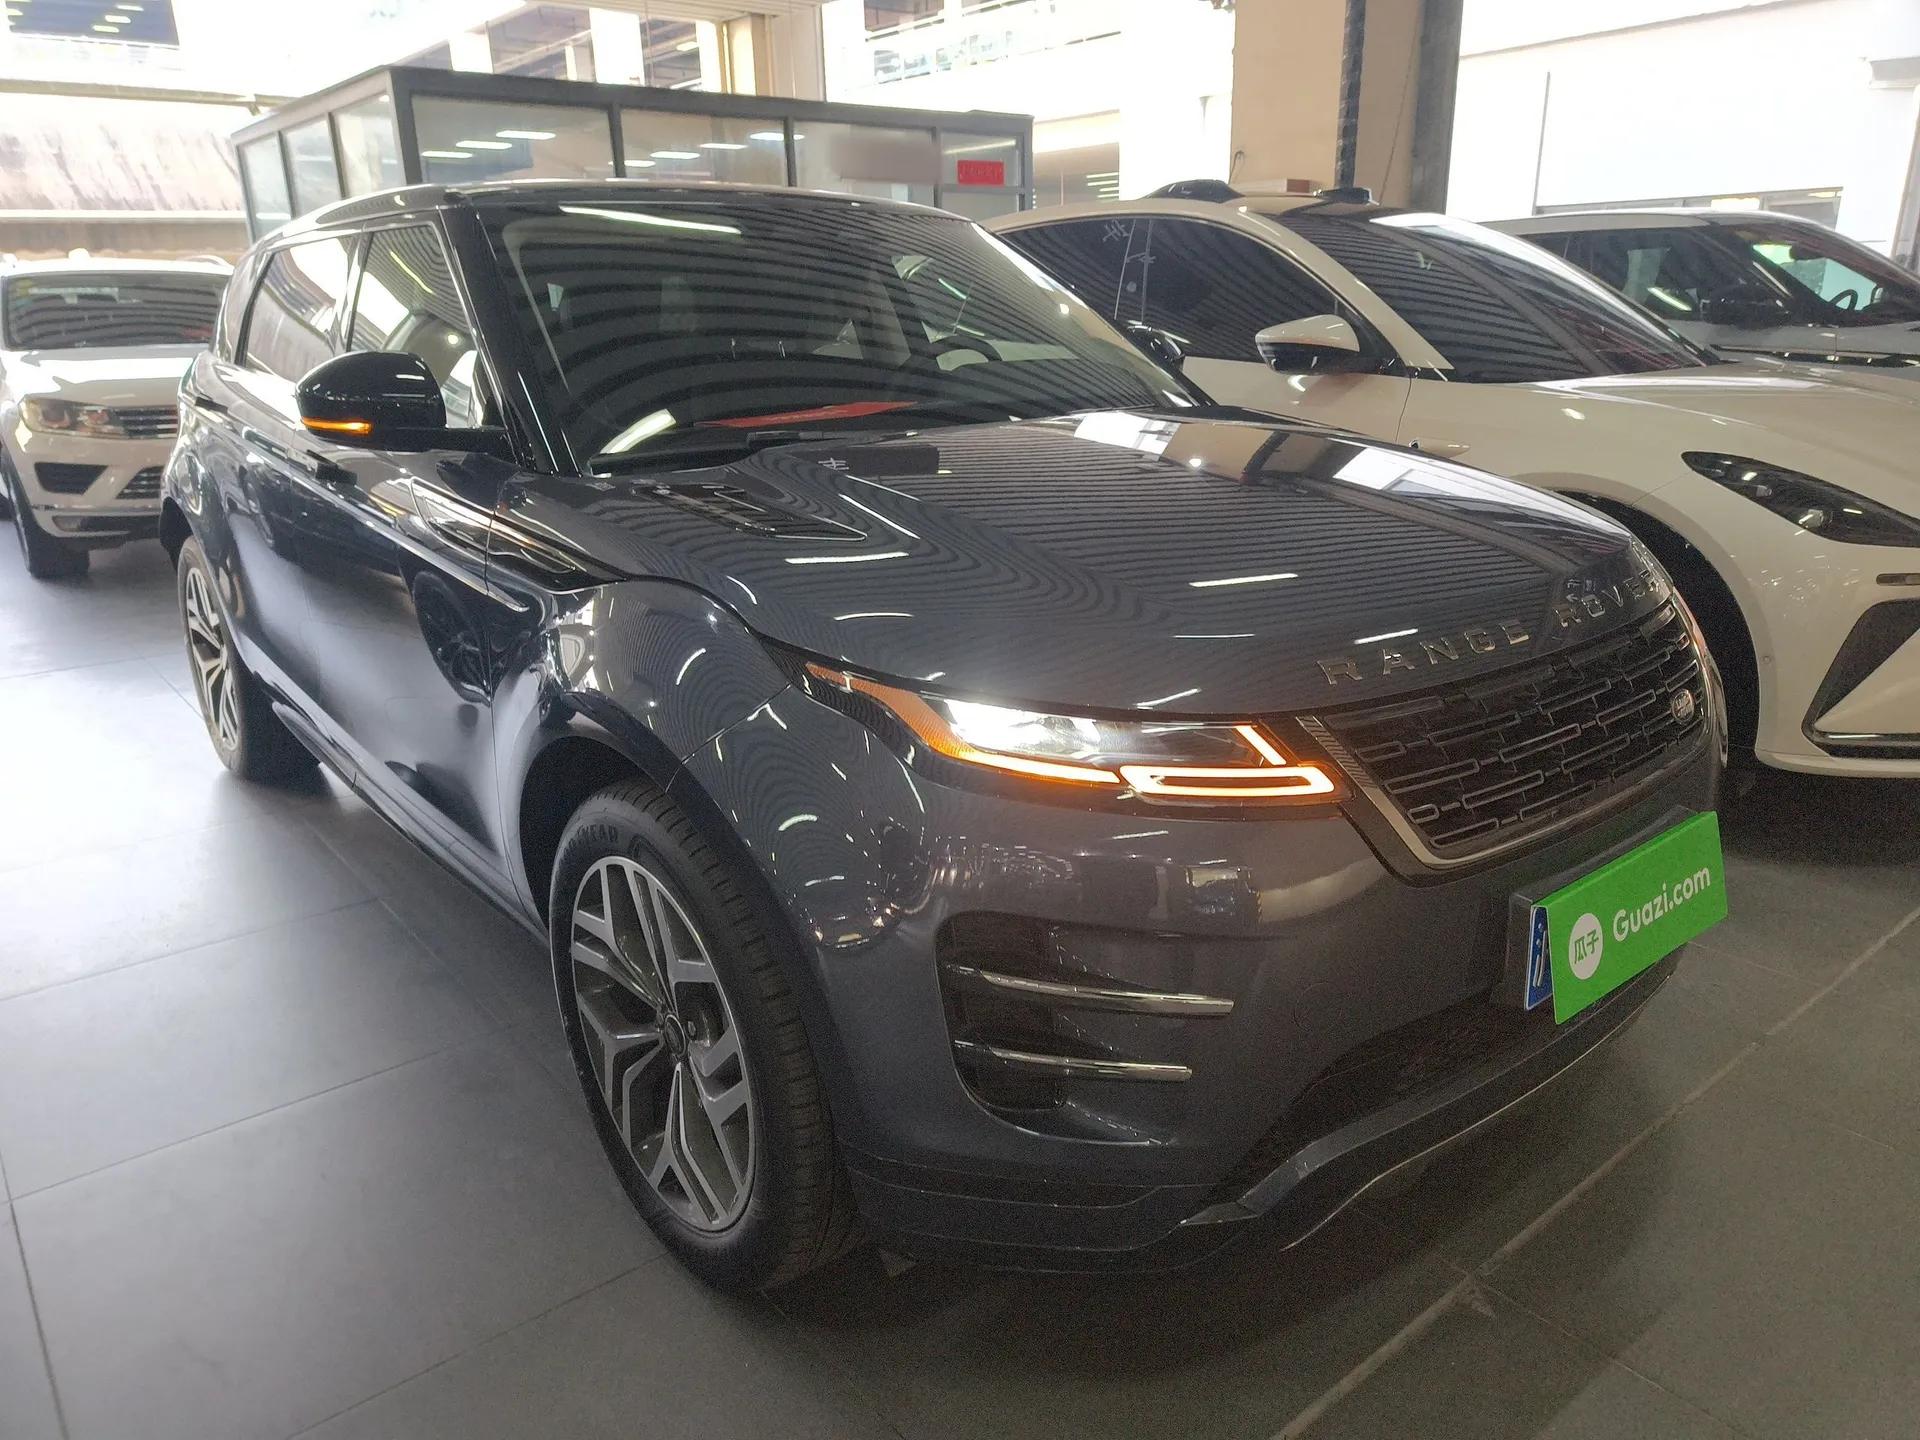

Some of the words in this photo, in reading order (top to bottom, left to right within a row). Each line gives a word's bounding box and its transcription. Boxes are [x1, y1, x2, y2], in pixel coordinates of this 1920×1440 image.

[1315, 619, 1530, 686] RANGE
[1613, 867, 1711, 942] Guazi.com
[1573, 928, 1600, 965] 瓜子
